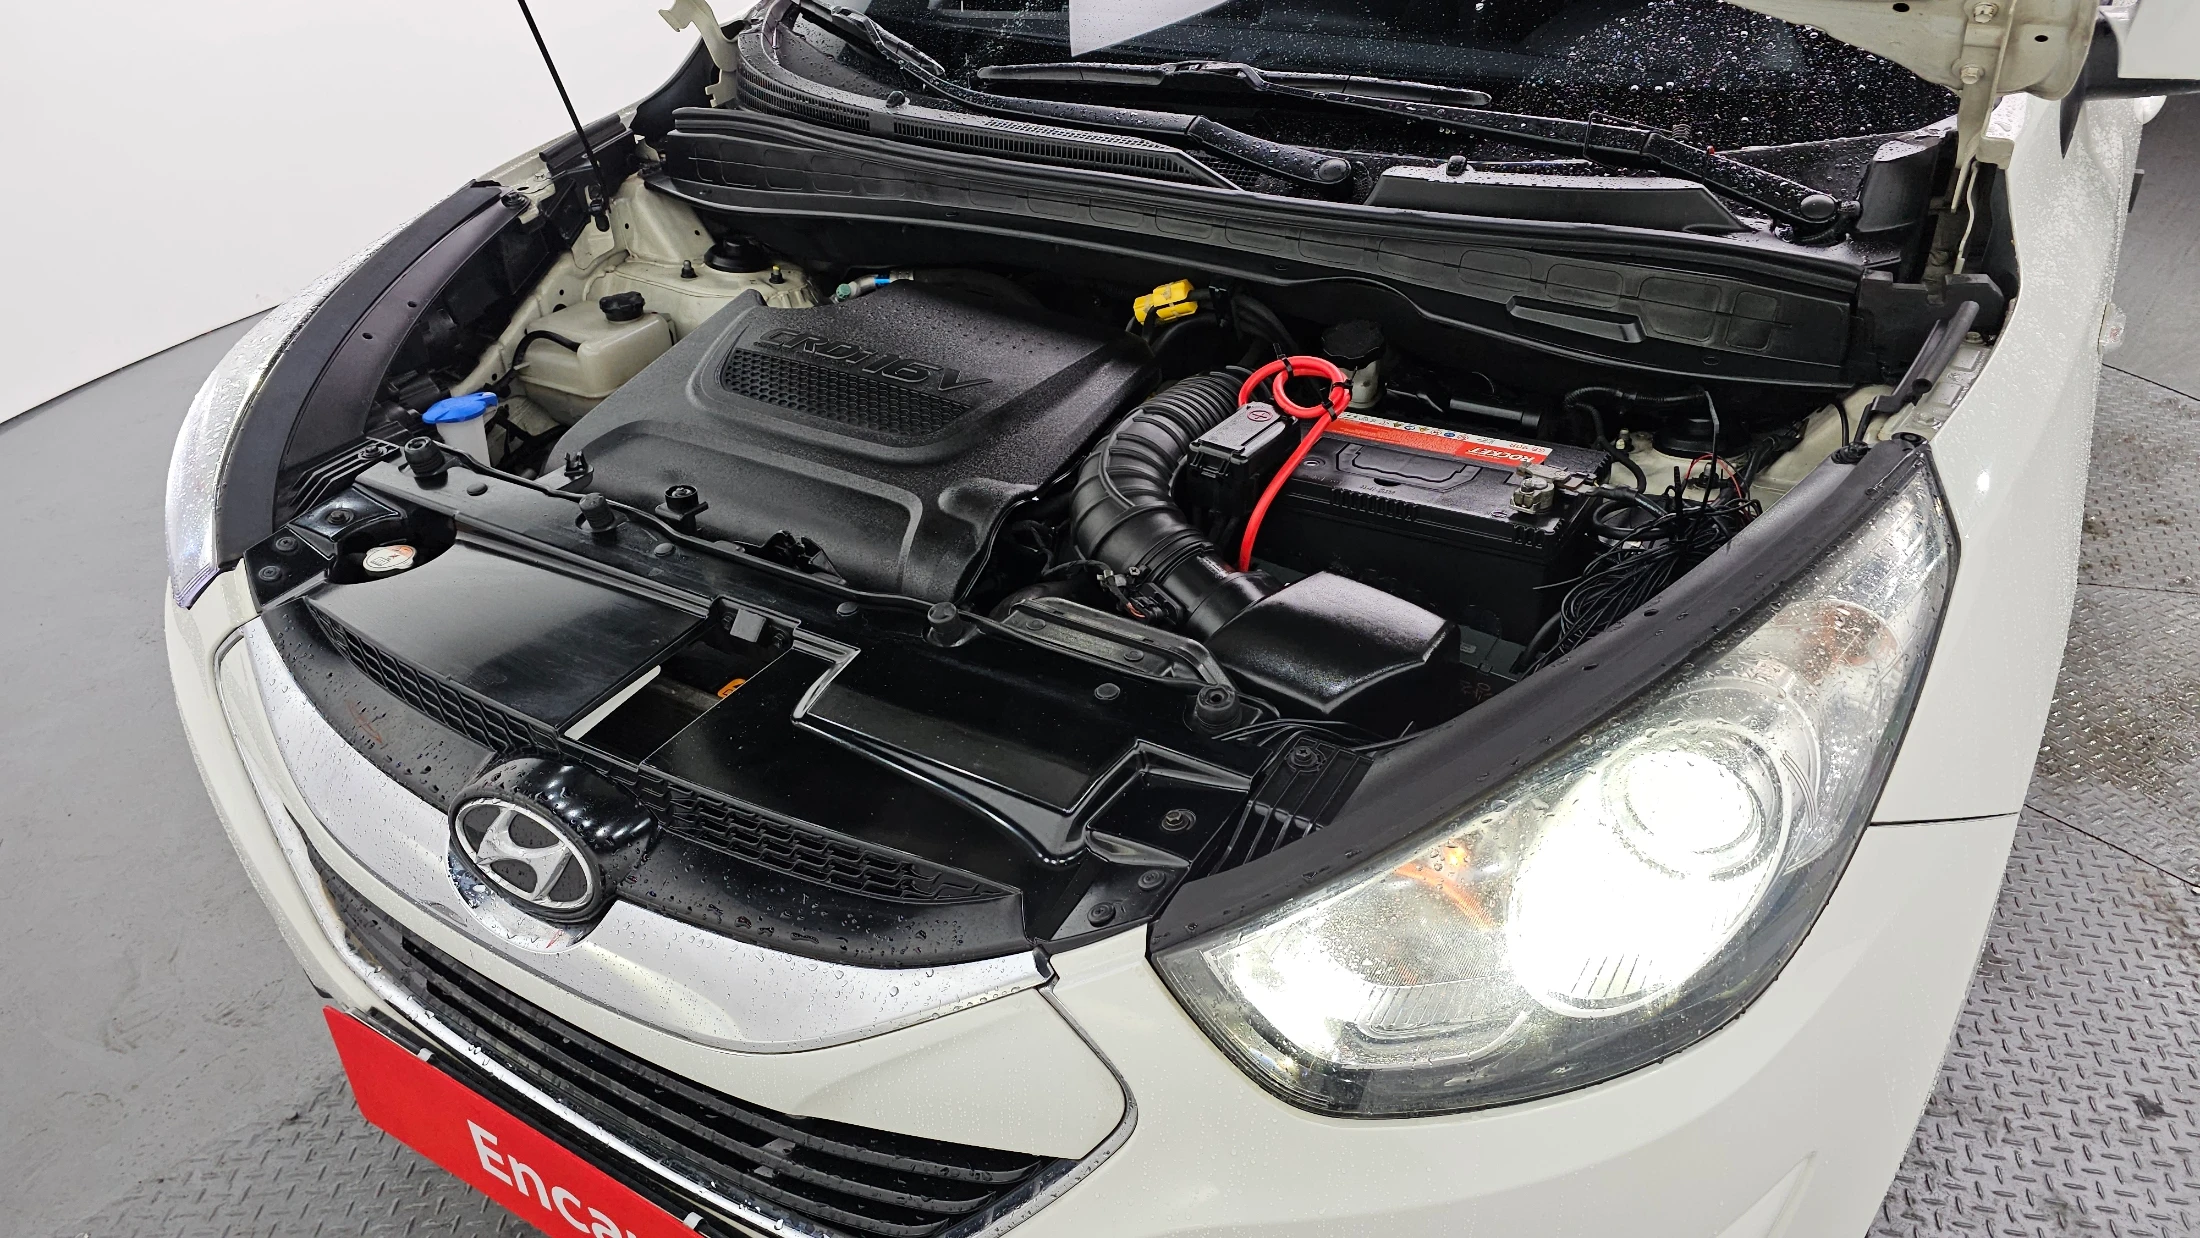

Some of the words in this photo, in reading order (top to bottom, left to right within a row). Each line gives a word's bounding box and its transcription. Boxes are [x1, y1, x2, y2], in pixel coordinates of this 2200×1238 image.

[862, 353, 994, 392] 16V
[1467, 447, 1536, 463] ROCKET
[467, 1119, 637, 1238] Enca
